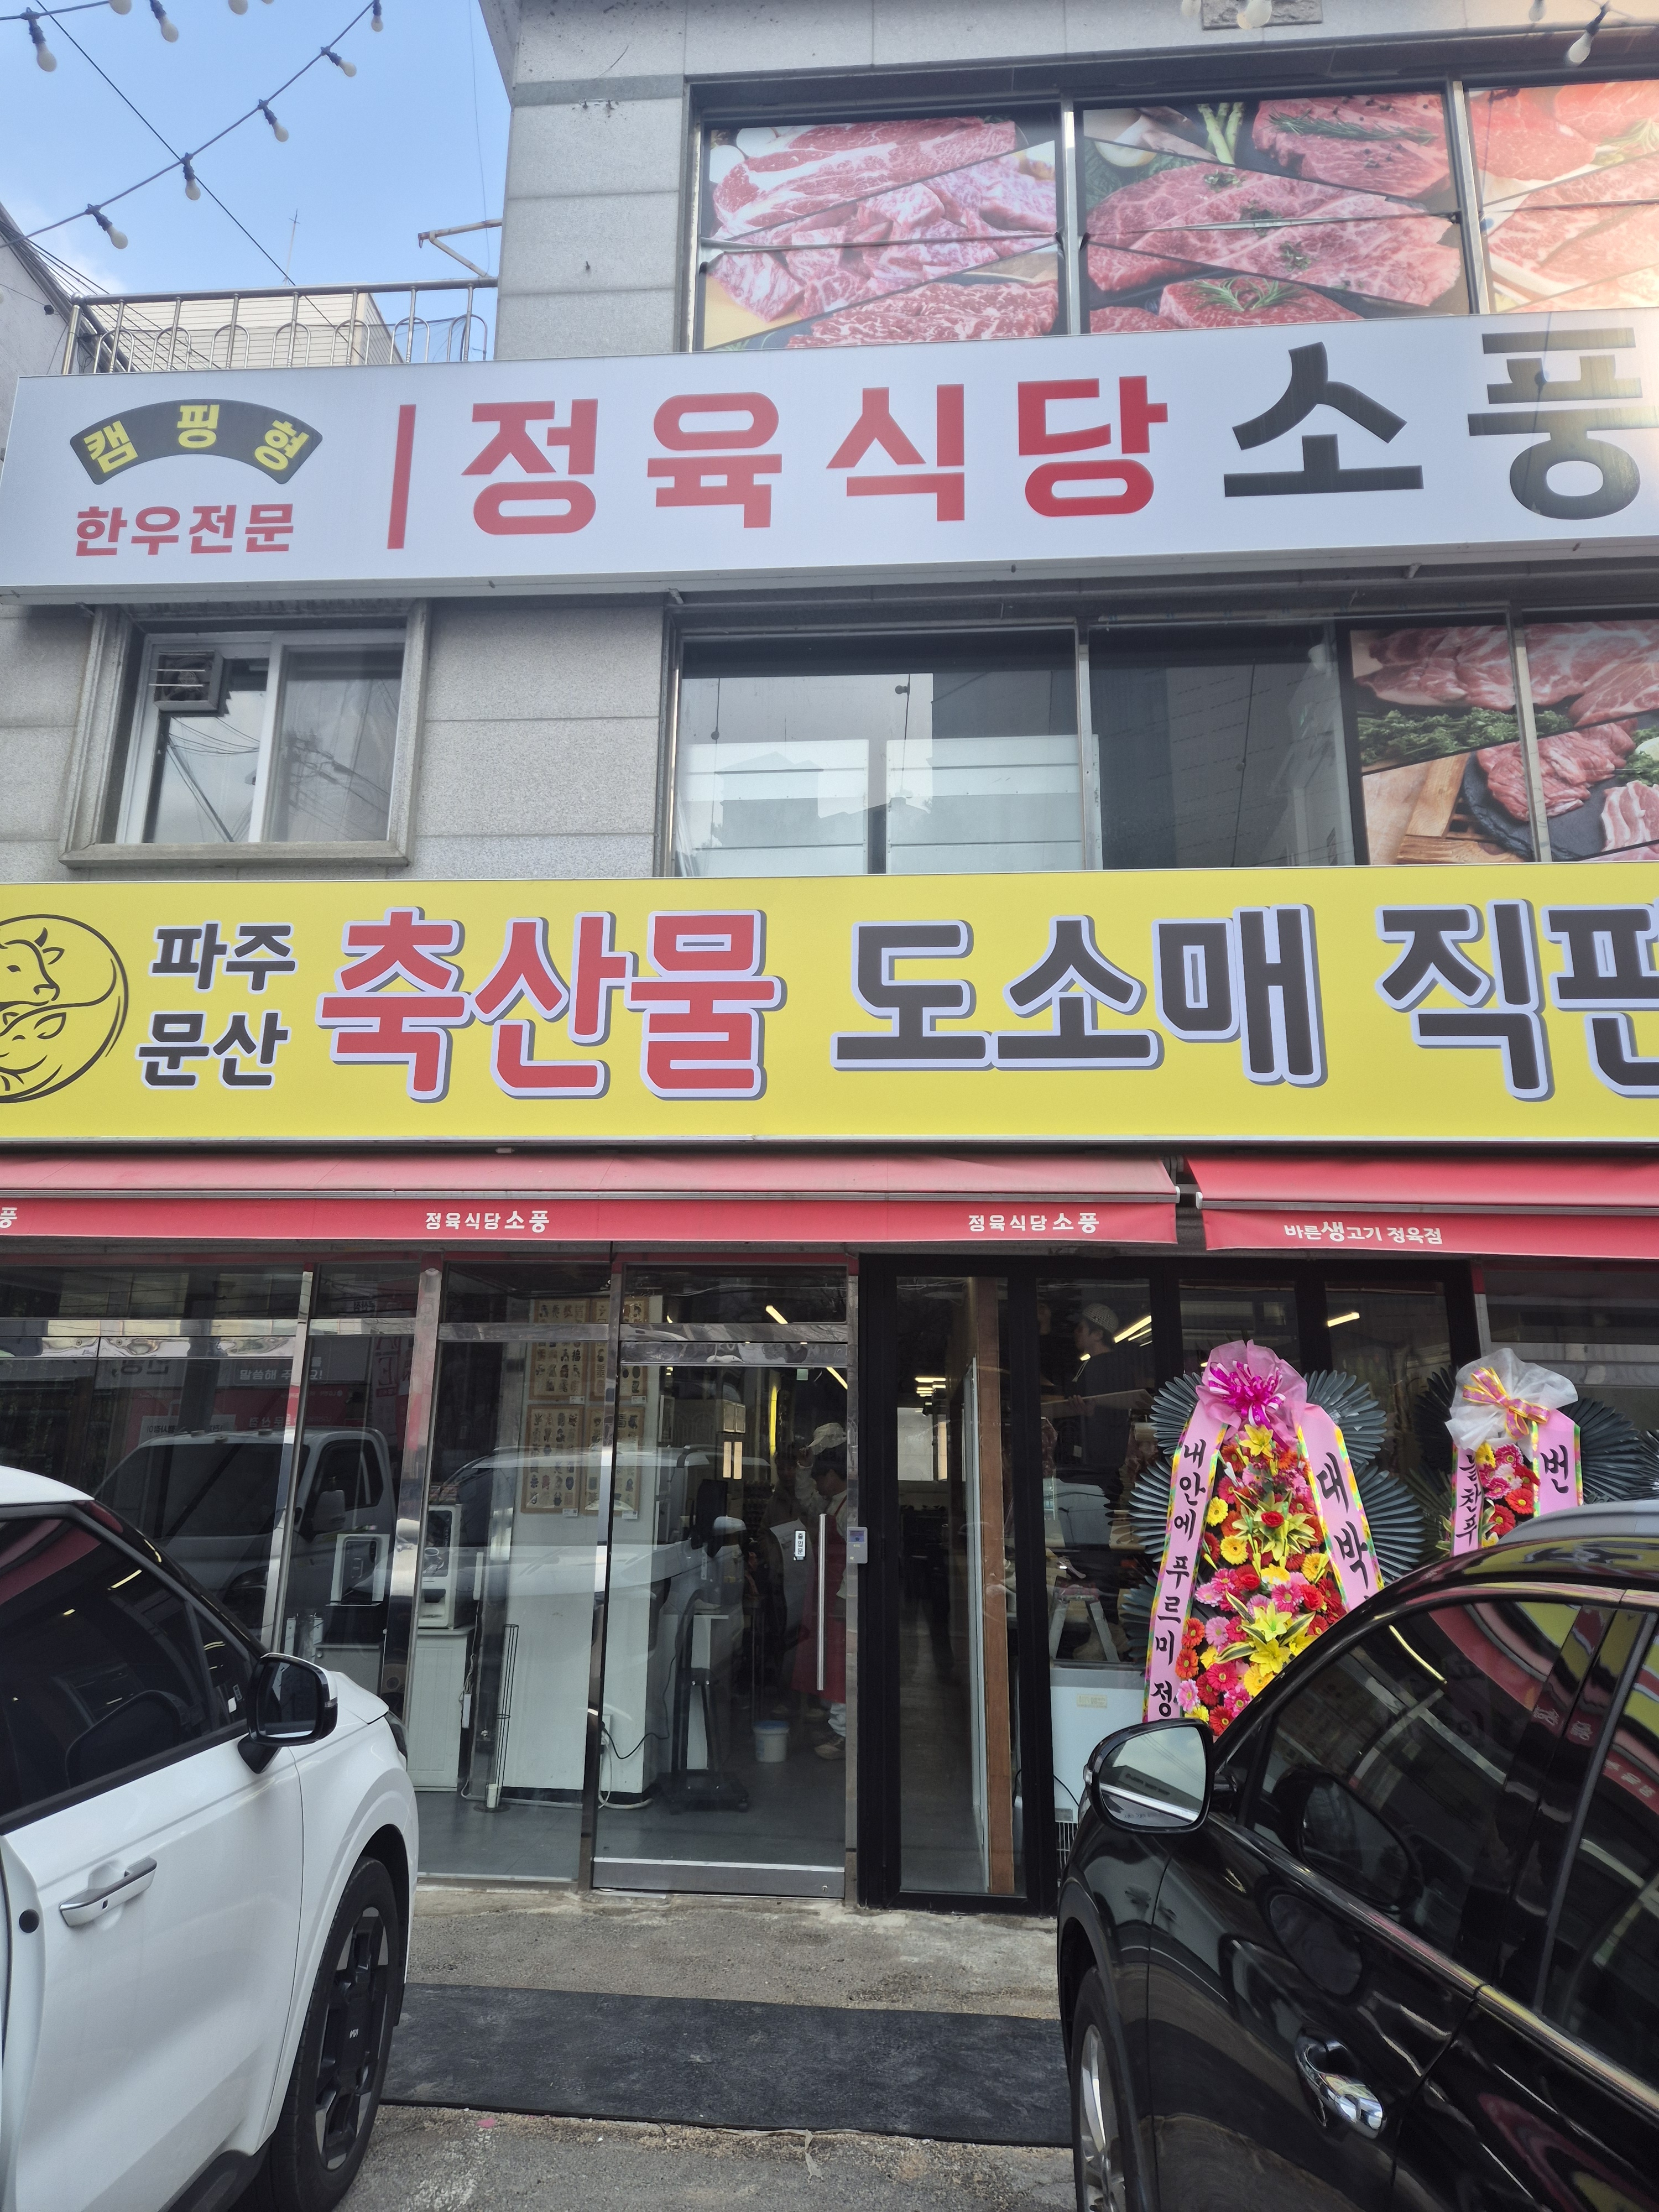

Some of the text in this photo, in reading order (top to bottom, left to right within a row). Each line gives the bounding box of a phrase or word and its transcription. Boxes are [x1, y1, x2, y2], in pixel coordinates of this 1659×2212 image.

[83, 404, 310, 473] 캠핑형
[1223, 327, 1659, 520] 소풍
[76, 503, 294, 556] 한우전문
[150, 922, 296, 992] 파주
[317, 907, 781, 1099] 축산물
[831, 905, 1322, 1084] 도소매
[138, 1012, 289, 1087] 문산
[1283, 1221, 1443, 1245] 바른생고기 정육점
[1173, 1438, 1207, 1542] 내안에
[1155, 1555, 1191, 1667] 푸르미
